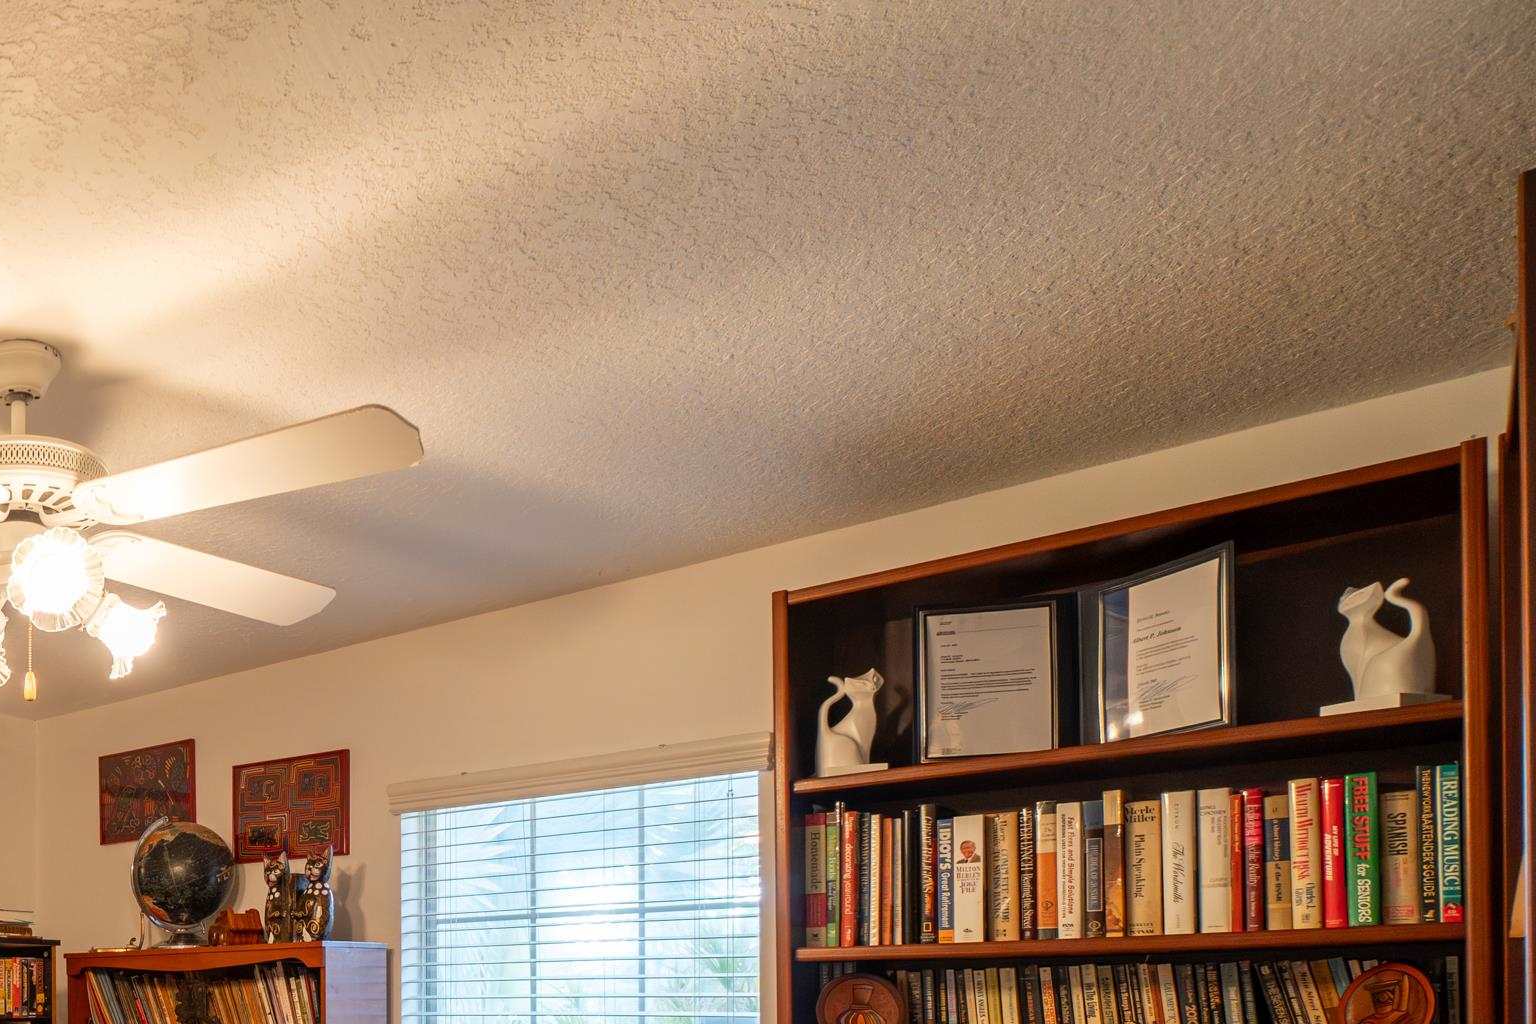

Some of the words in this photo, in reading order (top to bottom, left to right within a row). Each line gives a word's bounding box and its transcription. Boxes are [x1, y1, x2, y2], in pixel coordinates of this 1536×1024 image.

[1352, 776, 1370, 812] FREE
[1442, 781, 1460, 840] READING
[1066, 816, 1075, 830] Fast
[1353, 815, 1371, 860] STUFF
[1386, 812, 1410, 856] SPANISH
[810, 831, 823, 890] Homemade
[843, 843, 854, 879] decorating
[939, 828, 952, 871] IDIOT'S
[1067, 849, 1075, 862] and
[1134, 834, 1146, 858] Plain
[1323, 833, 1334, 881] ADVENTURE
[940, 872, 951, 892] Great
[1065, 863, 1075, 884] Simple
[1132, 858, 1147, 899] Speaking
[1356, 863, 1370, 877] for
[1443, 844, 1461, 886] MUSIC
[1067, 885, 1075, 915] Solutions
[1171, 865, 1186, 905] Wordsmiths
[1305, 882, 1317, 904] Charles
[1357, 878, 1373, 924] SENIORS
[940, 893, 951, 929] Retirement
